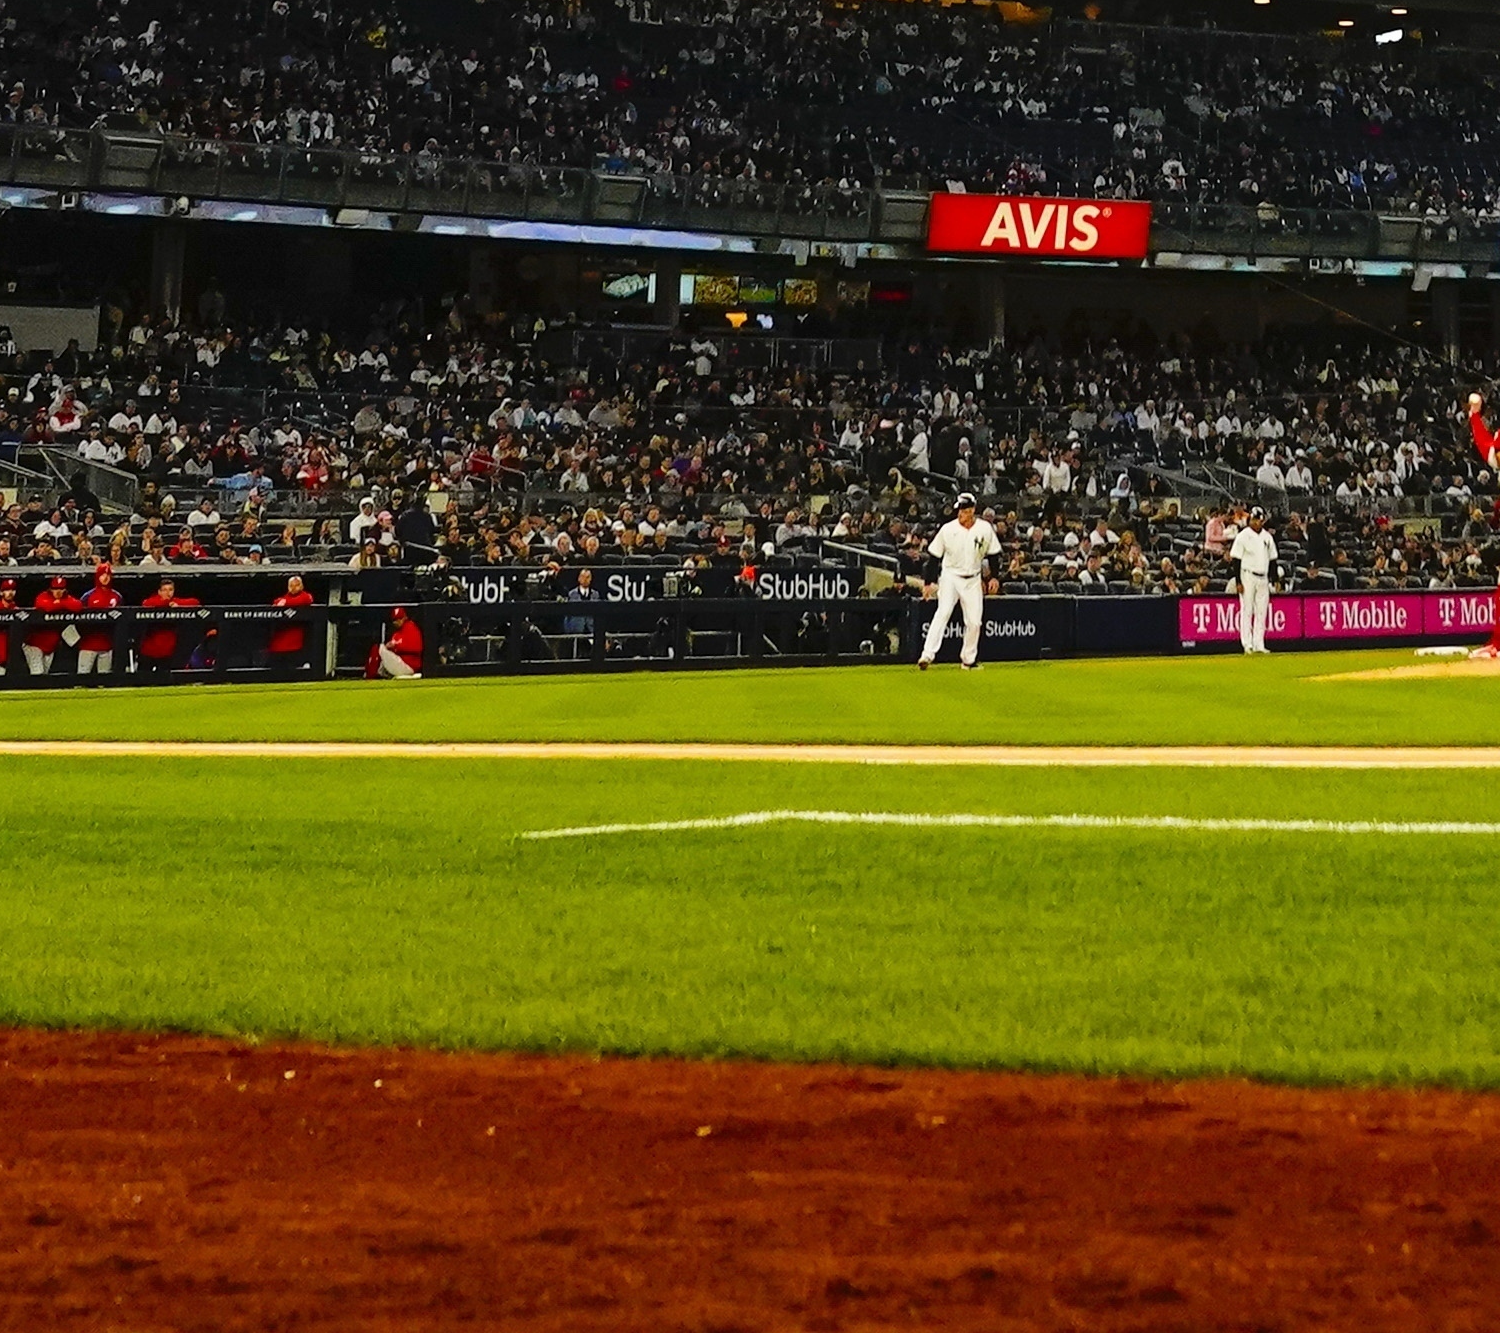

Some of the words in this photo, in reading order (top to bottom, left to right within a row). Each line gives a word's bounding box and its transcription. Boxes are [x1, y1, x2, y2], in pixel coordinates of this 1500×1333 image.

[759, 573, 850, 600] StubHub
[1341, 599, 1408, 630] Mobile
[985, 620, 1036, 637] StubHub
